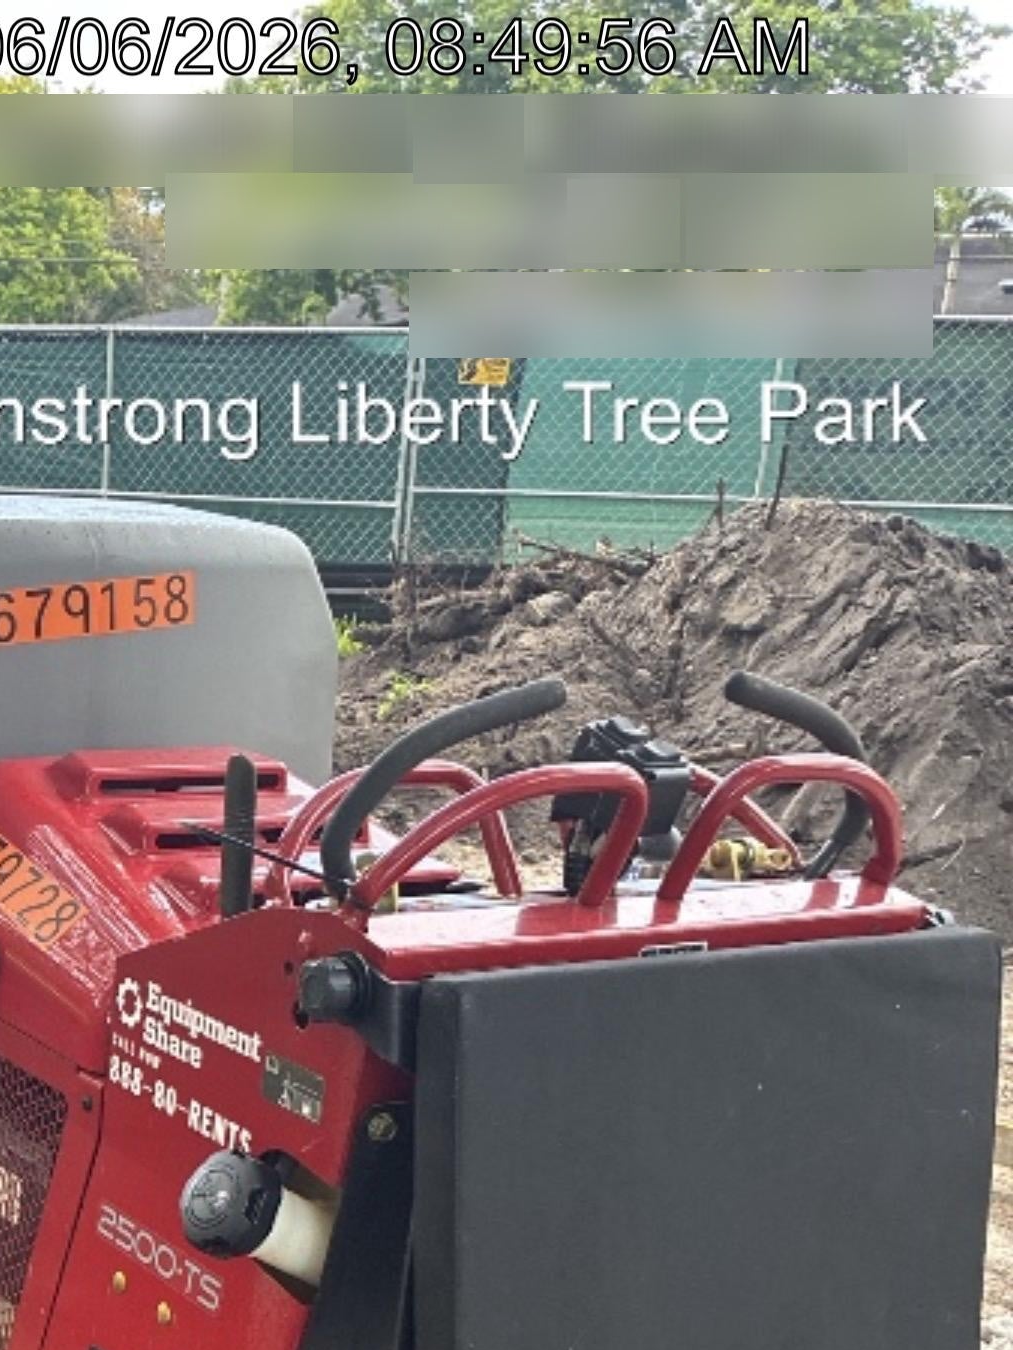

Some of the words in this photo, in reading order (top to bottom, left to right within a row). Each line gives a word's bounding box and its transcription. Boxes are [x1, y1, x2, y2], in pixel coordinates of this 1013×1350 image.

[143, 1016, 202, 1068] Share
[146, 981, 263, 1062] Equipment
[109, 1055, 252, 1153] 888-80-RENTS
